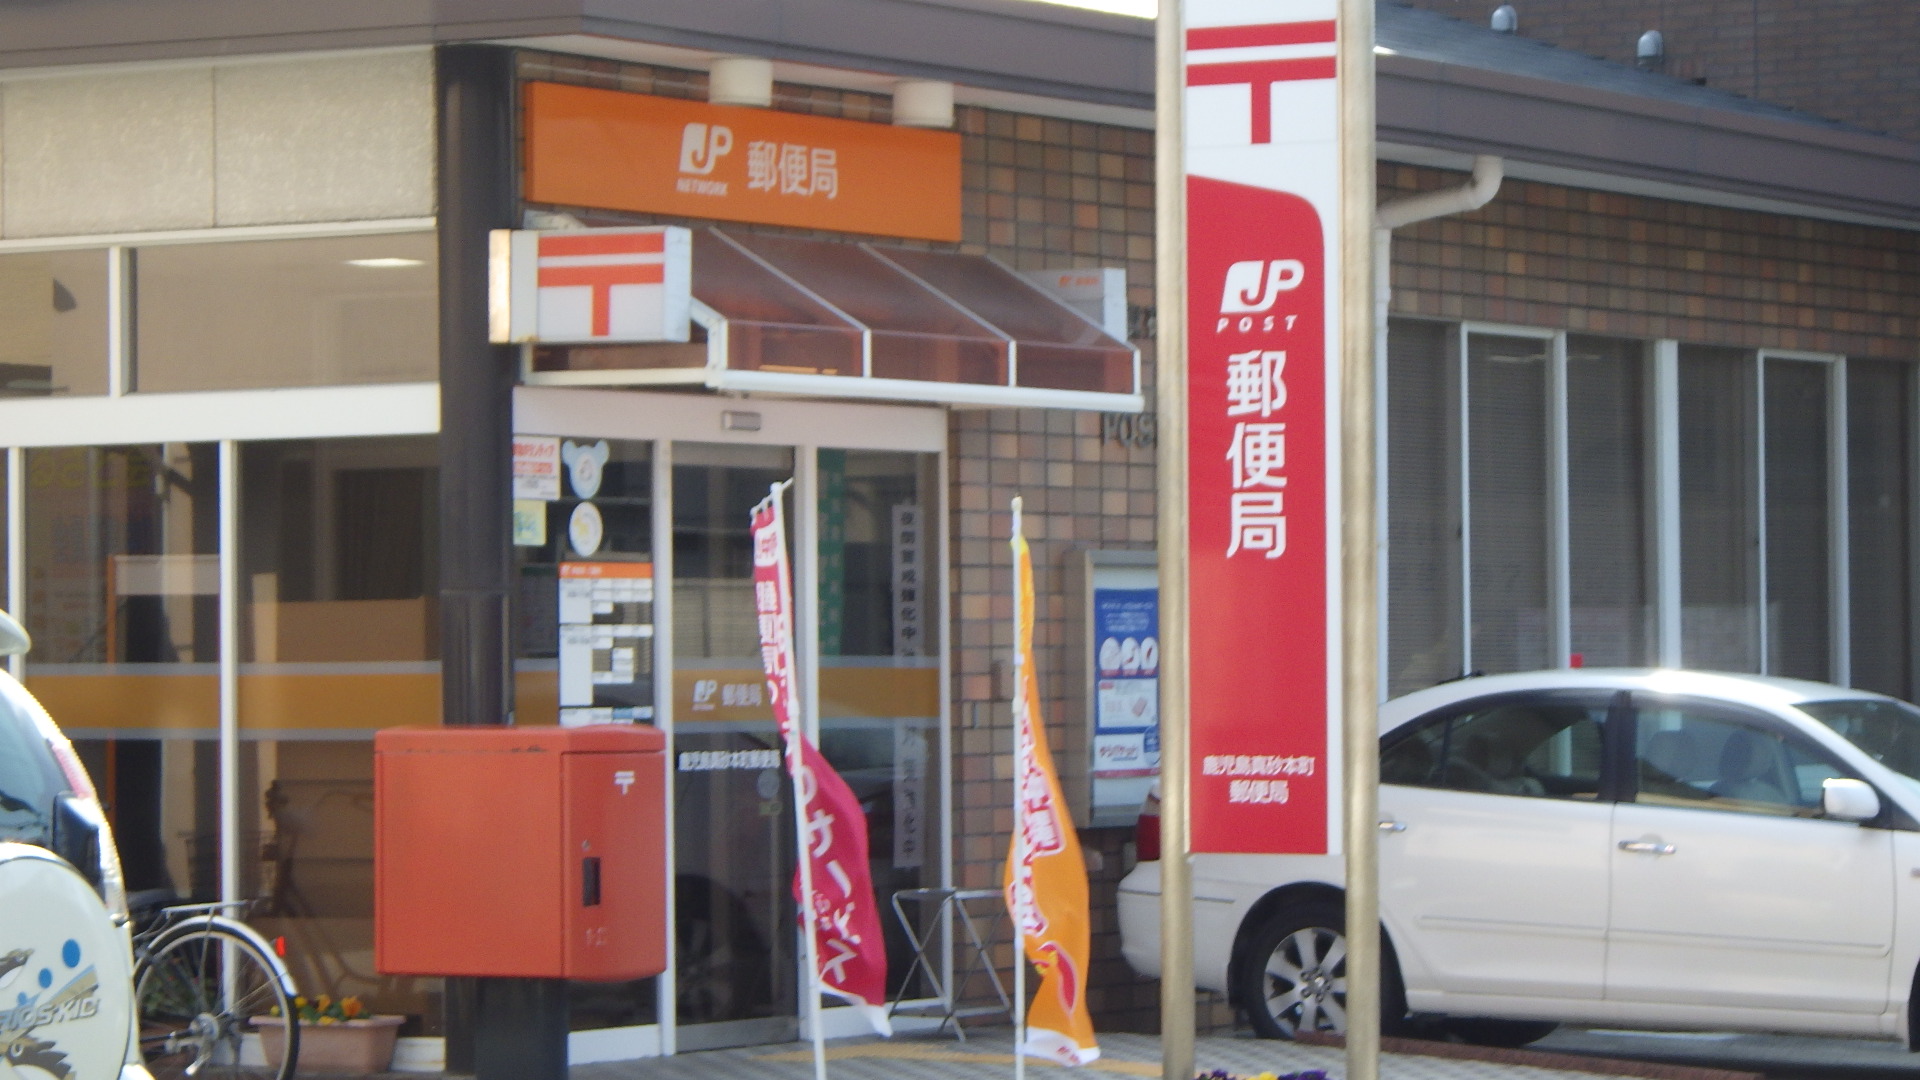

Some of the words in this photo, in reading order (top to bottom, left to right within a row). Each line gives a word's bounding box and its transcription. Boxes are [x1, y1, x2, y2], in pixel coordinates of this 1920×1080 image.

[679, 122, 733, 175] JP
[676, 177, 728, 196] NETWORK
[747, 140, 838, 199] 郵便局
[1220, 259, 1305, 314] JP
[1216, 315, 1298, 333] POST
[1226, 350, 1288, 559] 郵便局
[722, 684, 762, 707] 郵便局
[1229, 779, 1290, 804] 郵便局
